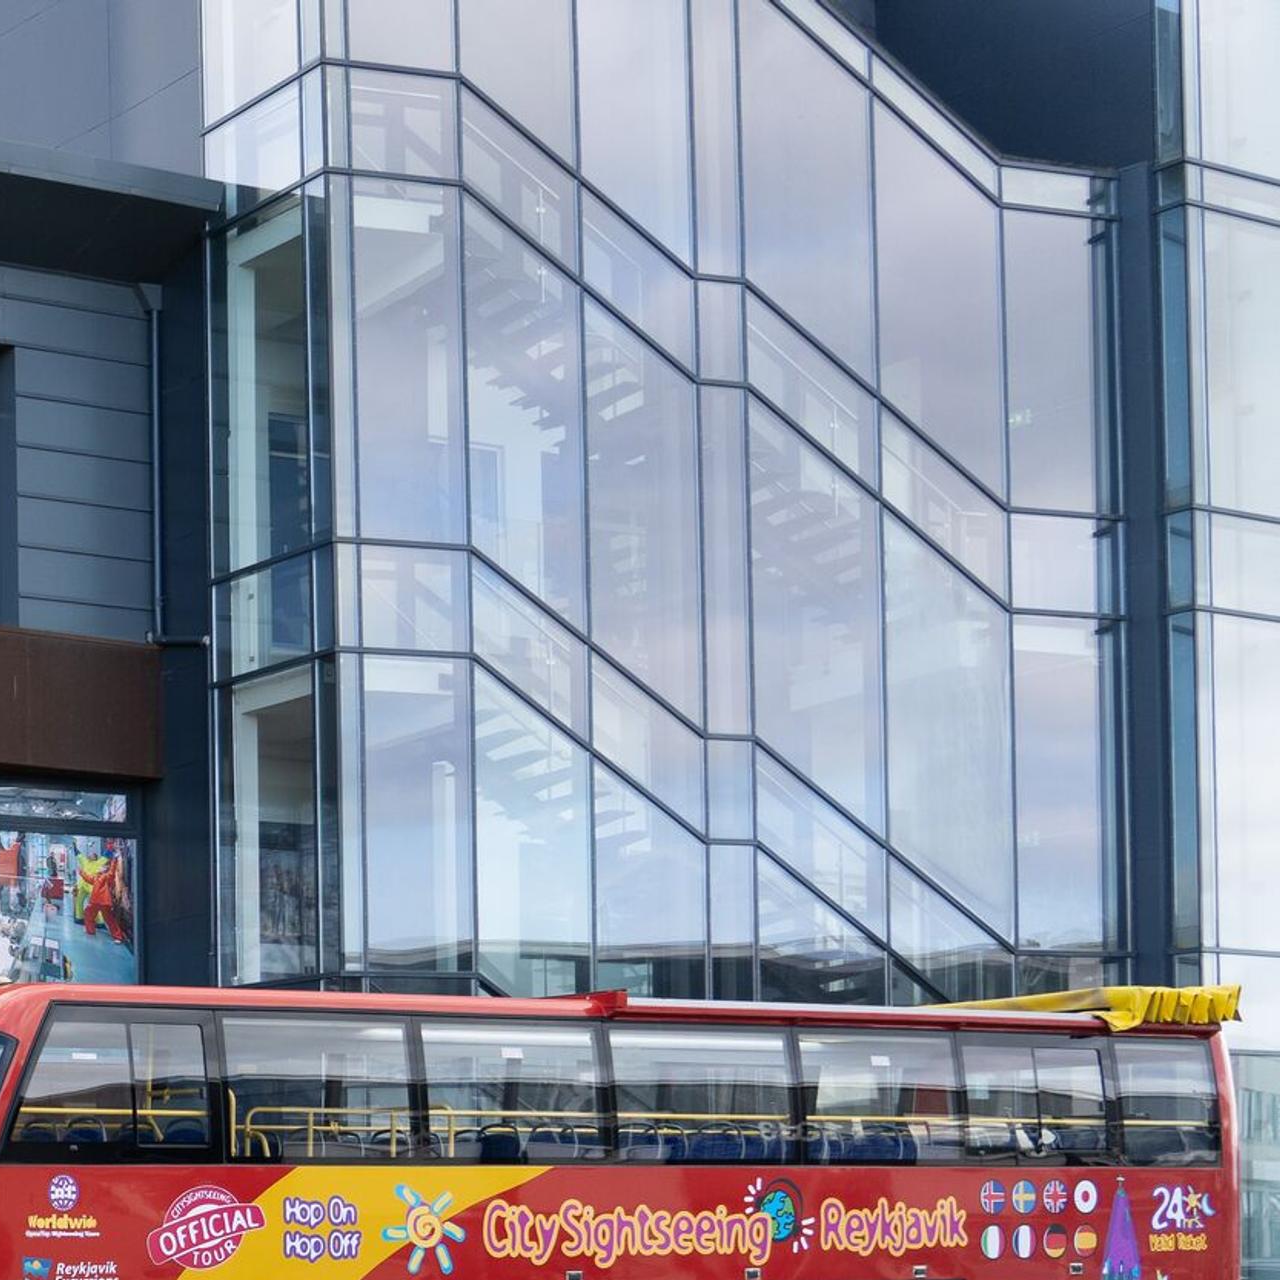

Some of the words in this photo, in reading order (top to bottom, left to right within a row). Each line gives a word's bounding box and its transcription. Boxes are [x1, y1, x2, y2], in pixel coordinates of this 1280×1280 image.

[285, 1198, 324, 1227] Hop
[328, 1197, 356, 1223] On
[1151, 1186, 1185, 1231] 24
[159, 1208, 260, 1256] OFFICIAL
[820, 1196, 968, 1257] Reykjavik
[192, 1239, 237, 1266] TOUR
[285, 1232, 324, 1262] Hop
[328, 1231, 361, 1257] Off
[56, 1261, 118, 1277] Reykjavik
